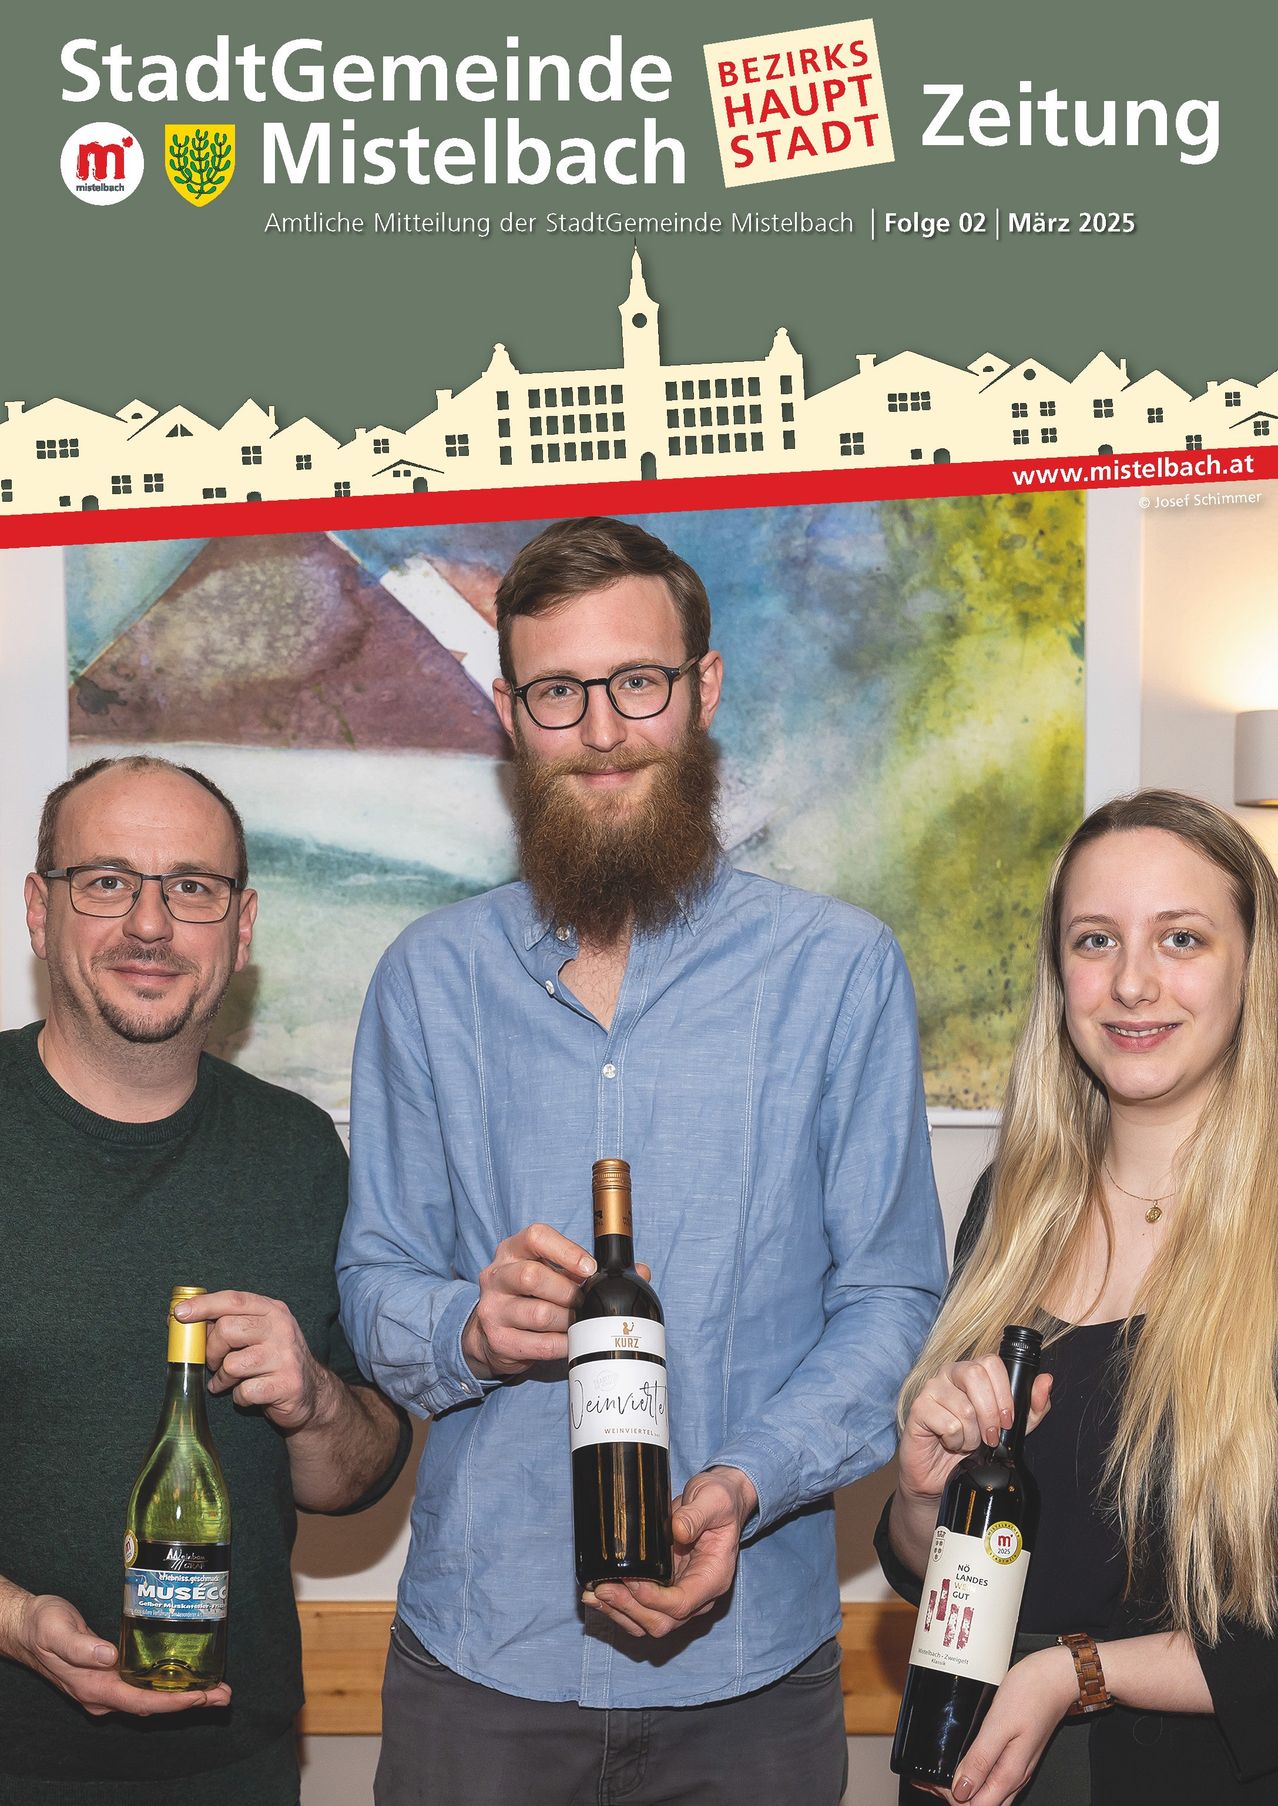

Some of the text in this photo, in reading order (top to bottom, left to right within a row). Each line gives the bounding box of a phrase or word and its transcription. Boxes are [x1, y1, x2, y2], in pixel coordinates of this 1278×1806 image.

[614, 1337, 640, 1349] KURZ
[604, 1428, 655, 1437] WEINVIERTEL
[957, 1564, 971, 1573] NÖ
[955, 1573, 989, 1587] LANDES
[952, 1591, 970, 1601] GUT
[944, 1654, 969, 1665] Zweigelt
